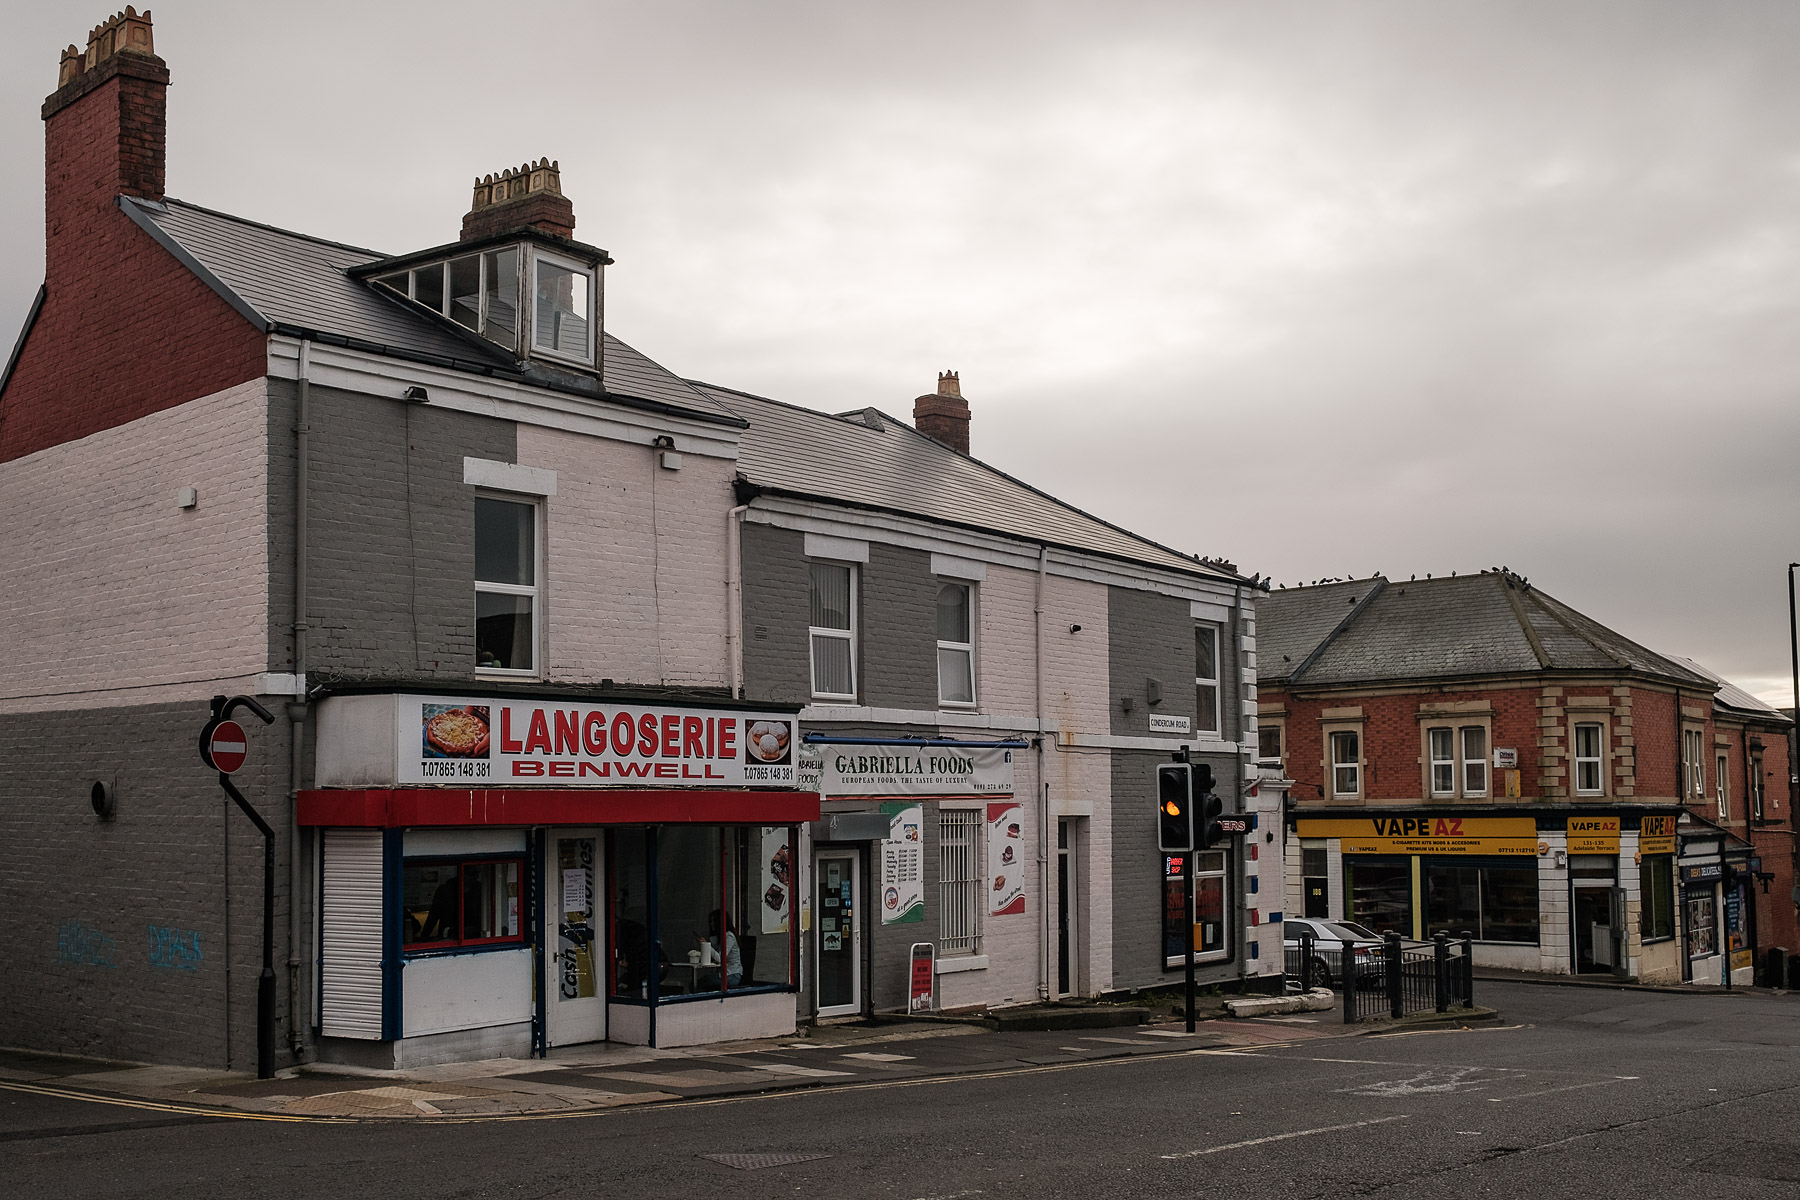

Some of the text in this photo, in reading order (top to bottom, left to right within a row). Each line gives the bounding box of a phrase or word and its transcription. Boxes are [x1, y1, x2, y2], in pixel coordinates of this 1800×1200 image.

[500, 706, 737, 759] LANGOSERIE
[1151, 718, 1175, 728] CONDERCUM
[1176, 720, 1187, 729] ROAD
[421, 761, 490, 777] T.07865 148 381
[512, 761, 725, 779] BENWELL
[744, 767, 793, 780] T.07865 148 381
[798, 760, 823, 770] ABRIELLA
[835, 755, 974, 775] GABRIELLA FOODS
[1372, 818, 1464, 836] VAPE AZ
[1571, 822, 1616, 831] VAPE AZ
[1644, 817, 1664, 835] VAPE
[1665, 817, 1674, 834] AZ
[560, 947, 578, 999] Cash
